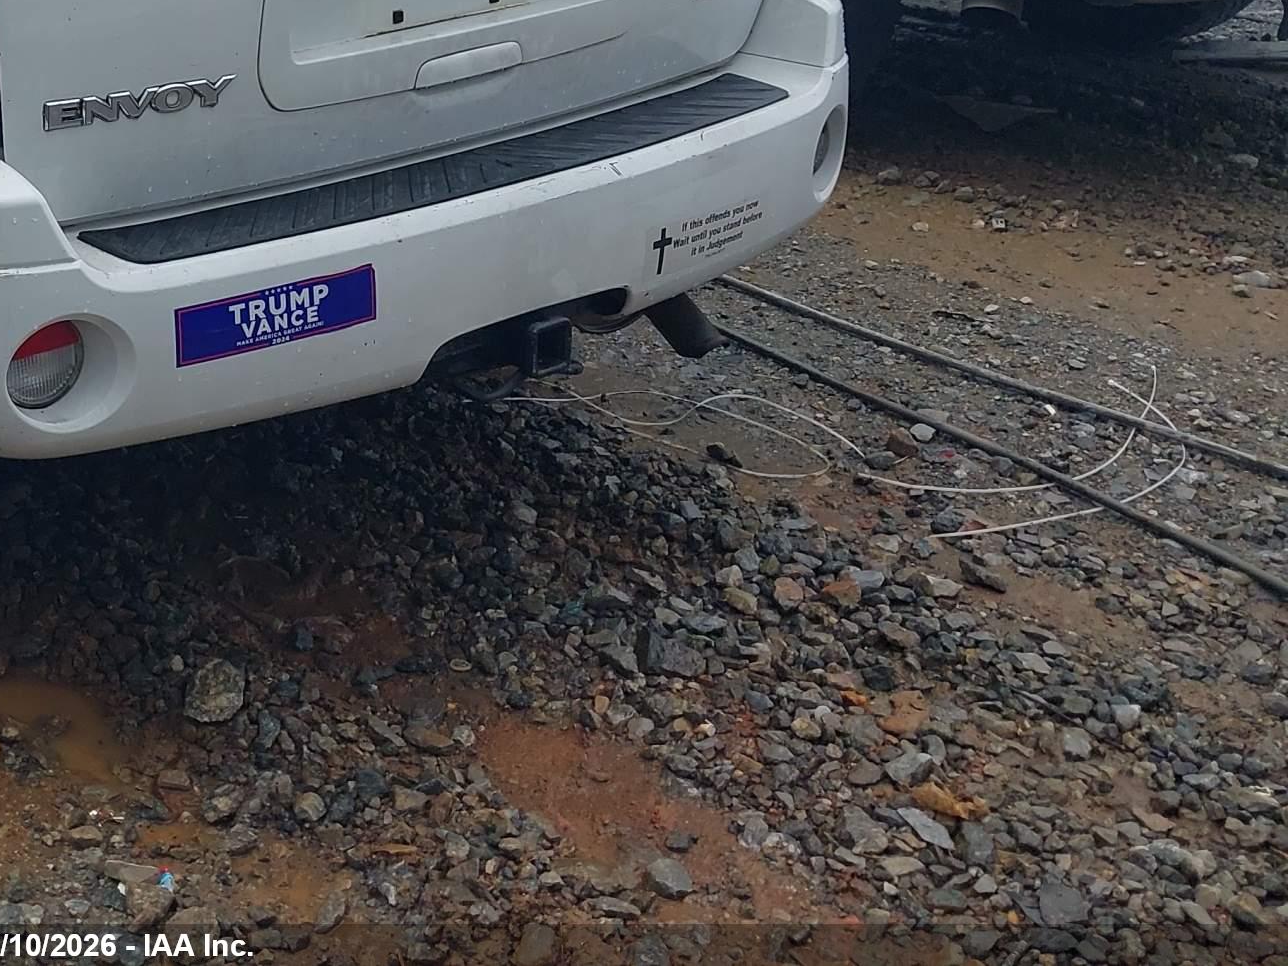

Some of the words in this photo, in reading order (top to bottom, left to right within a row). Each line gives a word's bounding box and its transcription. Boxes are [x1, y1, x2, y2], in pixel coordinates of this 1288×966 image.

[42, 73, 238, 132] ENVOY
[673, 236, 690, 249] Wait
[691, 230, 708, 242] until
[709, 227, 721, 240] you
[723, 218, 742, 232] stand
[743, 212, 763, 225] before
[690, 218, 703, 230] this
[705, 210, 731, 225] offends
[732, 206, 745, 218] you
[745, 201, 759, 211] now
[698, 245, 705, 253] in
[706, 231, 744, 250] Judgement
[229, 284, 329, 325] TRUMP
[236, 338, 254, 347] MAKE
[255, 331, 282, 342] AMERICA
[283, 326, 303, 335] GREAT
[241, 306, 319, 338] VANCE
[272, 335, 290, 345] 2024
